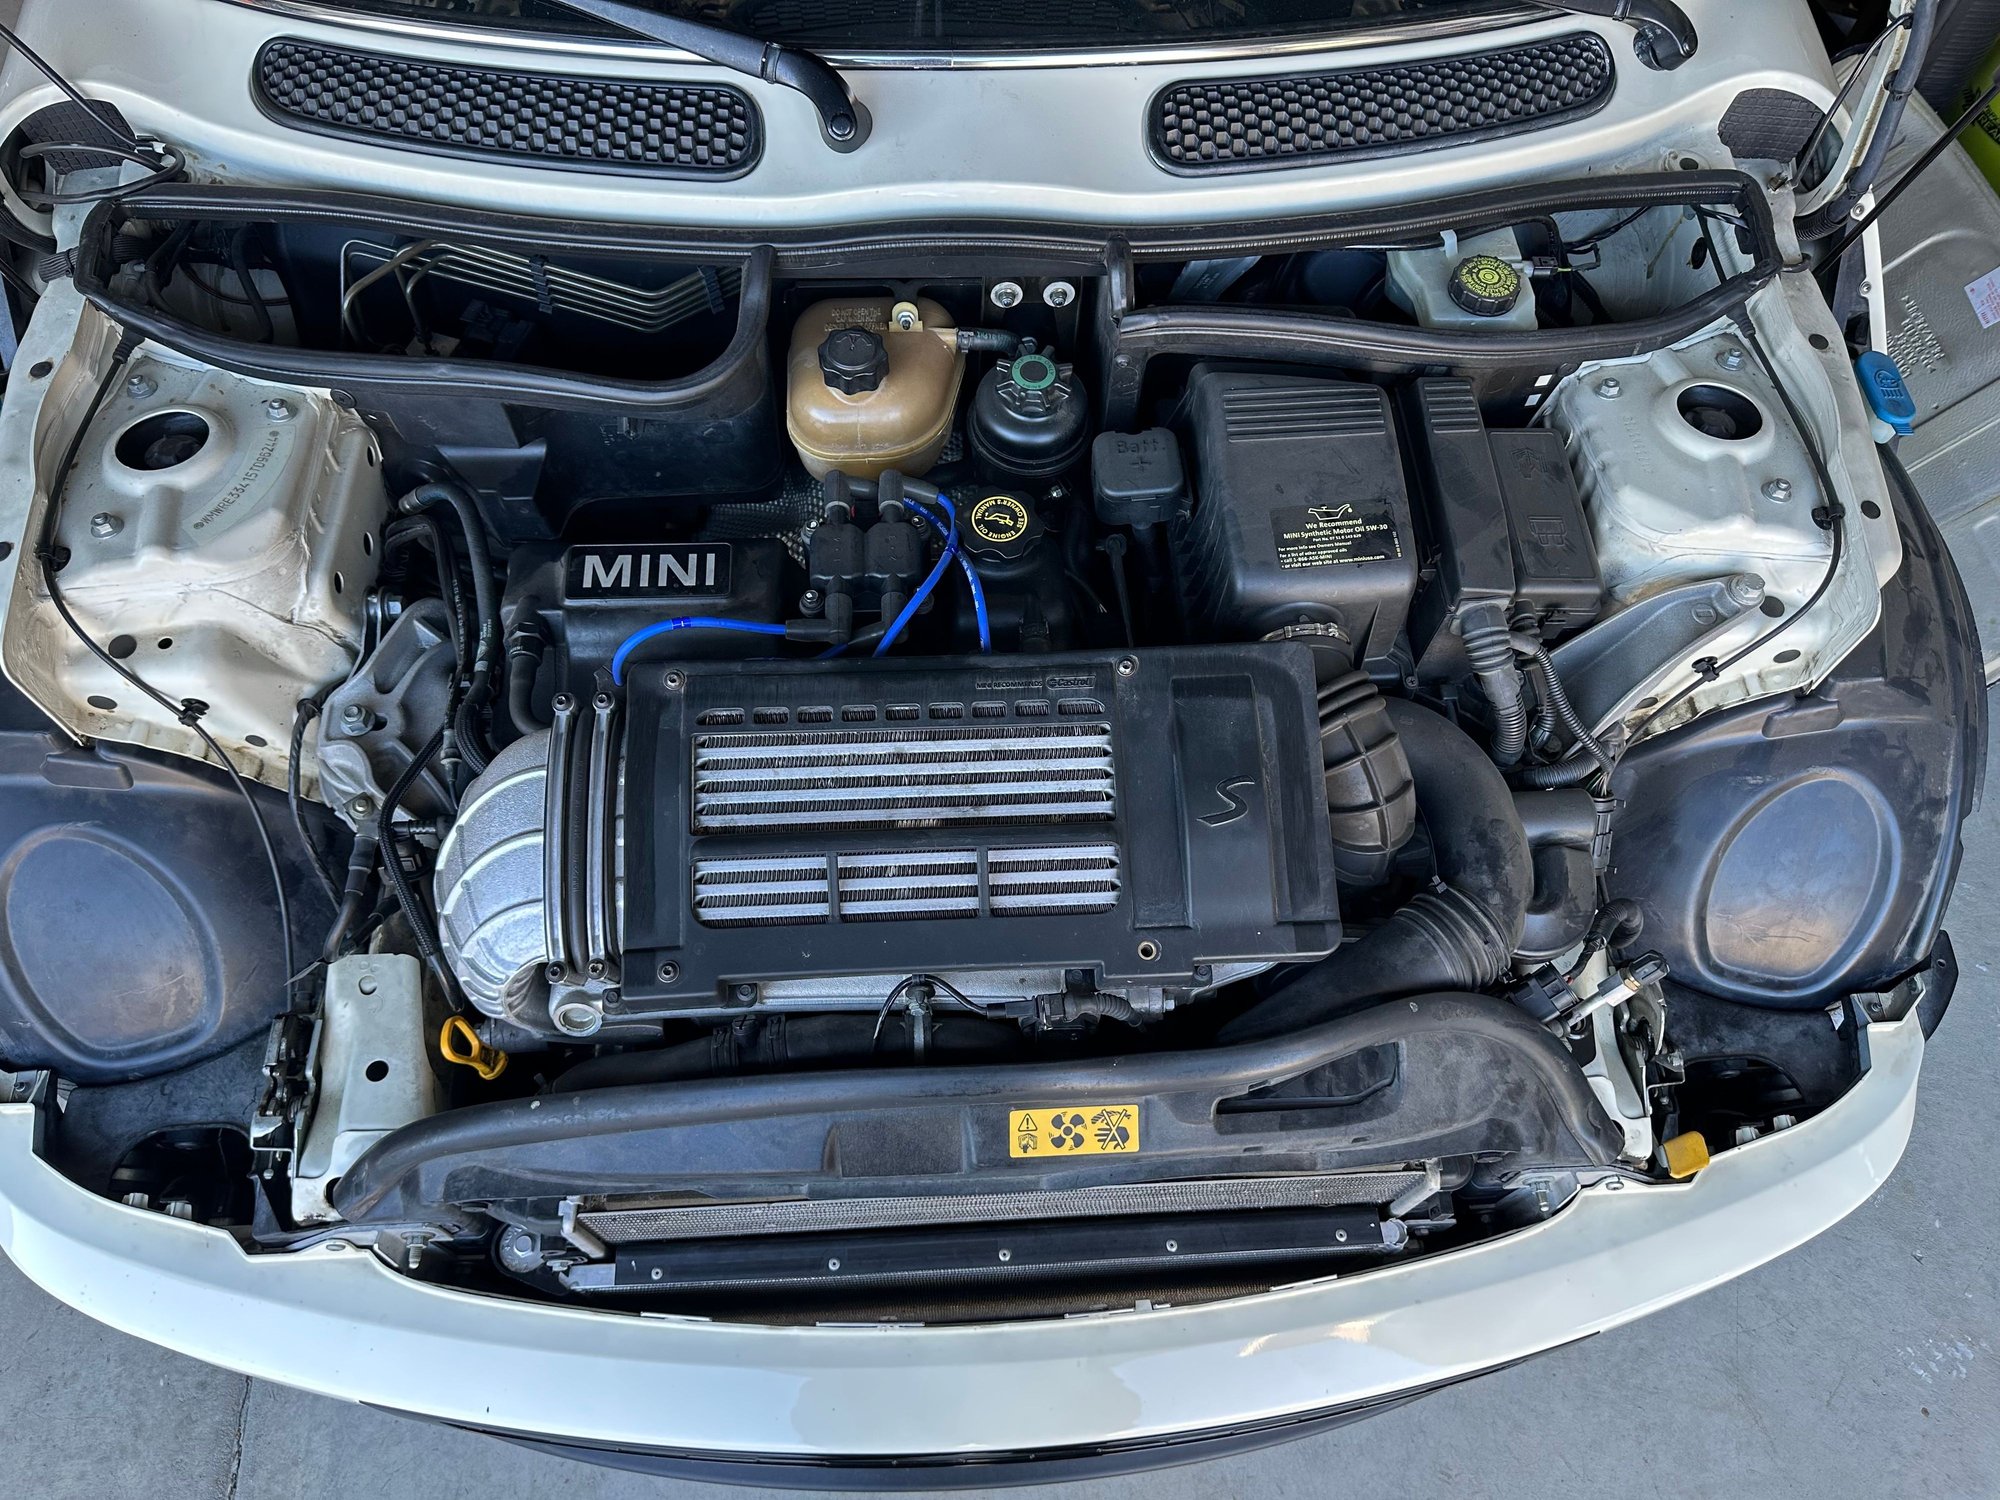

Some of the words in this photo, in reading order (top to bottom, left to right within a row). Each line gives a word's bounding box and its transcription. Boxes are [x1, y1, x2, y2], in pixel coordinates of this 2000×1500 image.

[975, 499, 996, 520] MANUAL
[996, 499, 1023, 517] OWNER'S
[978, 523, 988, 534] OIL
[1016, 517, 1025, 529] SEE
[1301, 530, 1332, 539] Synthetic
[1333, 527, 1353, 535] Motor
[1366, 523, 1388, 531] 5W-30
[1319, 518, 1362, 528] Recommend
[987, 530, 1016, 539] ENGINE
[582, 553, 716, 588] MINI
[1196, 774, 1255, 828] S
